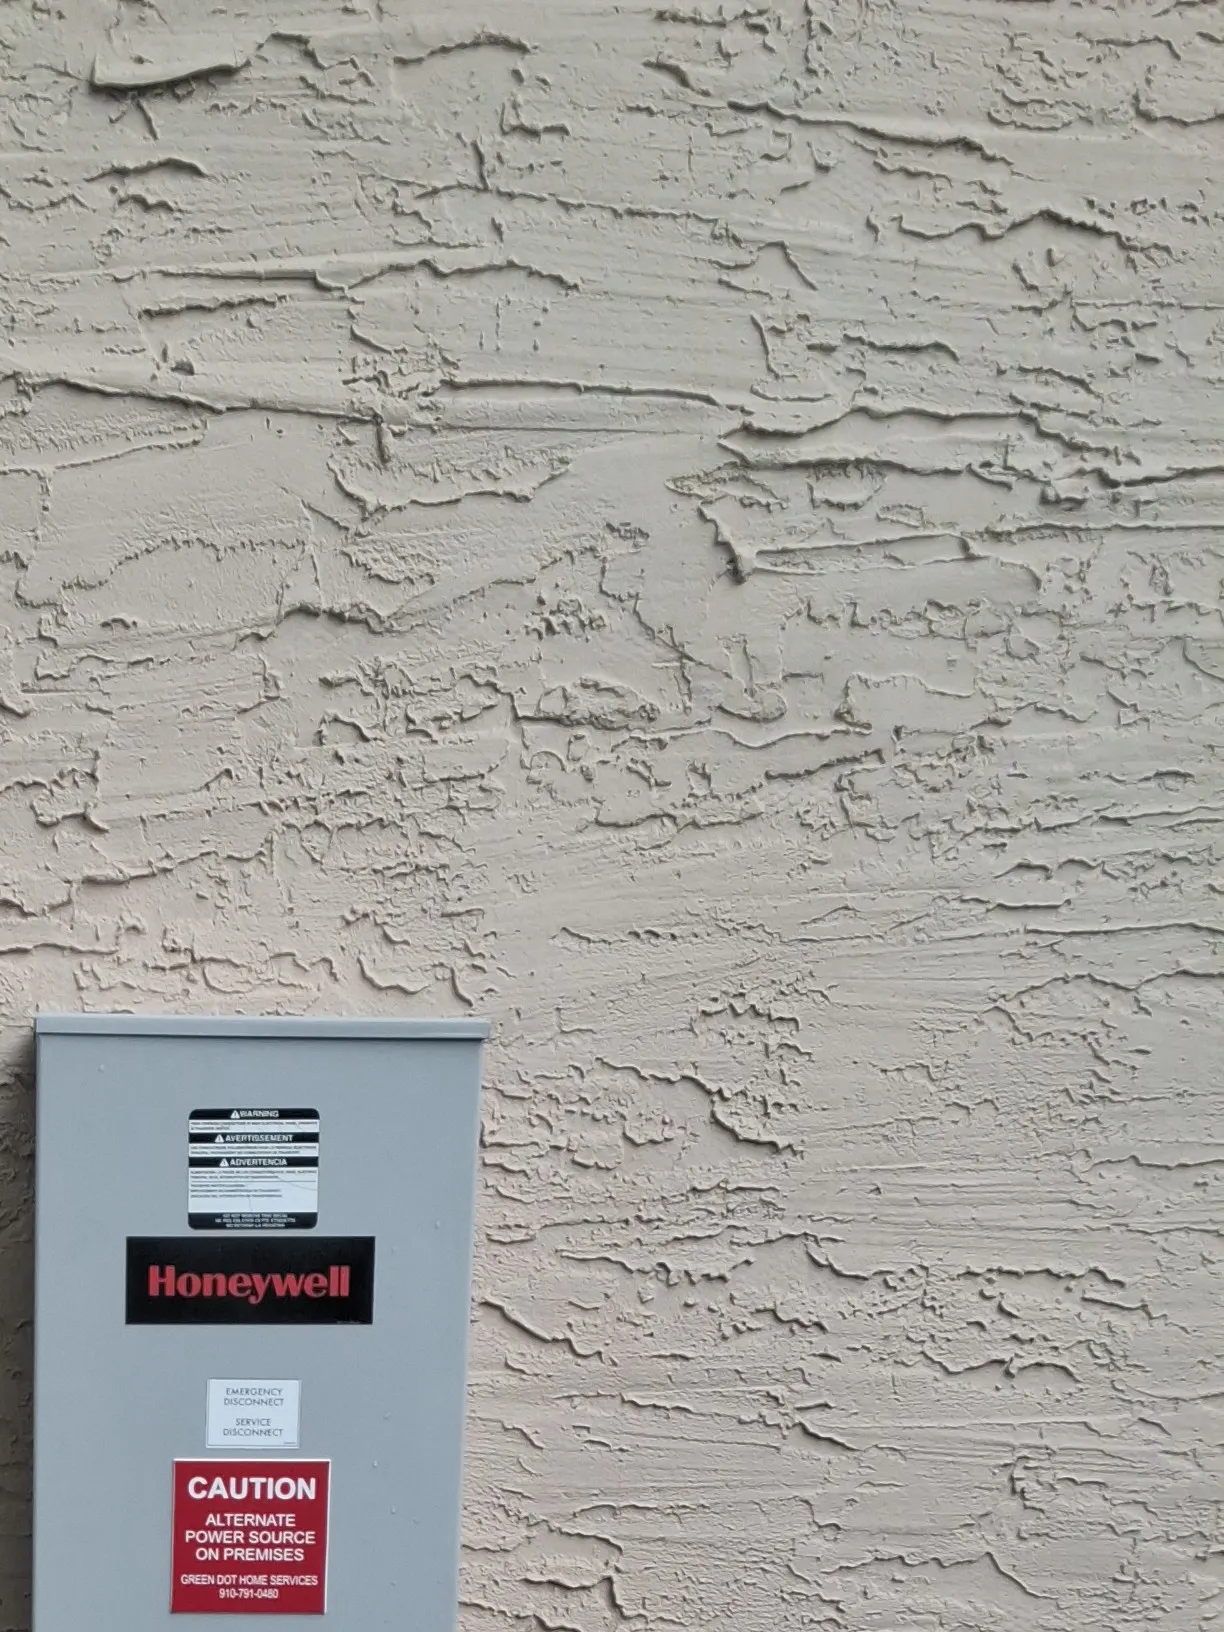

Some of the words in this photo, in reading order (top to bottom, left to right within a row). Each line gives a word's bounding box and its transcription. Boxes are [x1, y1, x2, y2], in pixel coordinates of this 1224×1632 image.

[229, 1158, 288, 1166] ADVERTENCIA
[148, 1264, 351, 1305] Honeywell
[225, 1387, 283, 1396] EMERGENCY
[223, 1398, 285, 1406] DISCONNECT
[235, 1418, 272, 1426] SERVICE
[223, 1428, 284, 1437] DISCONNECT
[187, 1476, 316, 1500] CAUTION
[205, 1513, 296, 1527] ALTERNATE
[185, 1530, 244, 1544] POWER
[248, 1531, 316, 1544] SOURCE
[195, 1548, 219, 1561] ON
[223, 1548, 305, 1561] PREMISES
[180, 1574, 215, 1585] GREEN
[216, 1574, 237, 1585] DOT
[239, 1575, 267, 1585] HOME
[269, 1575, 318, 1586] SERVICES
